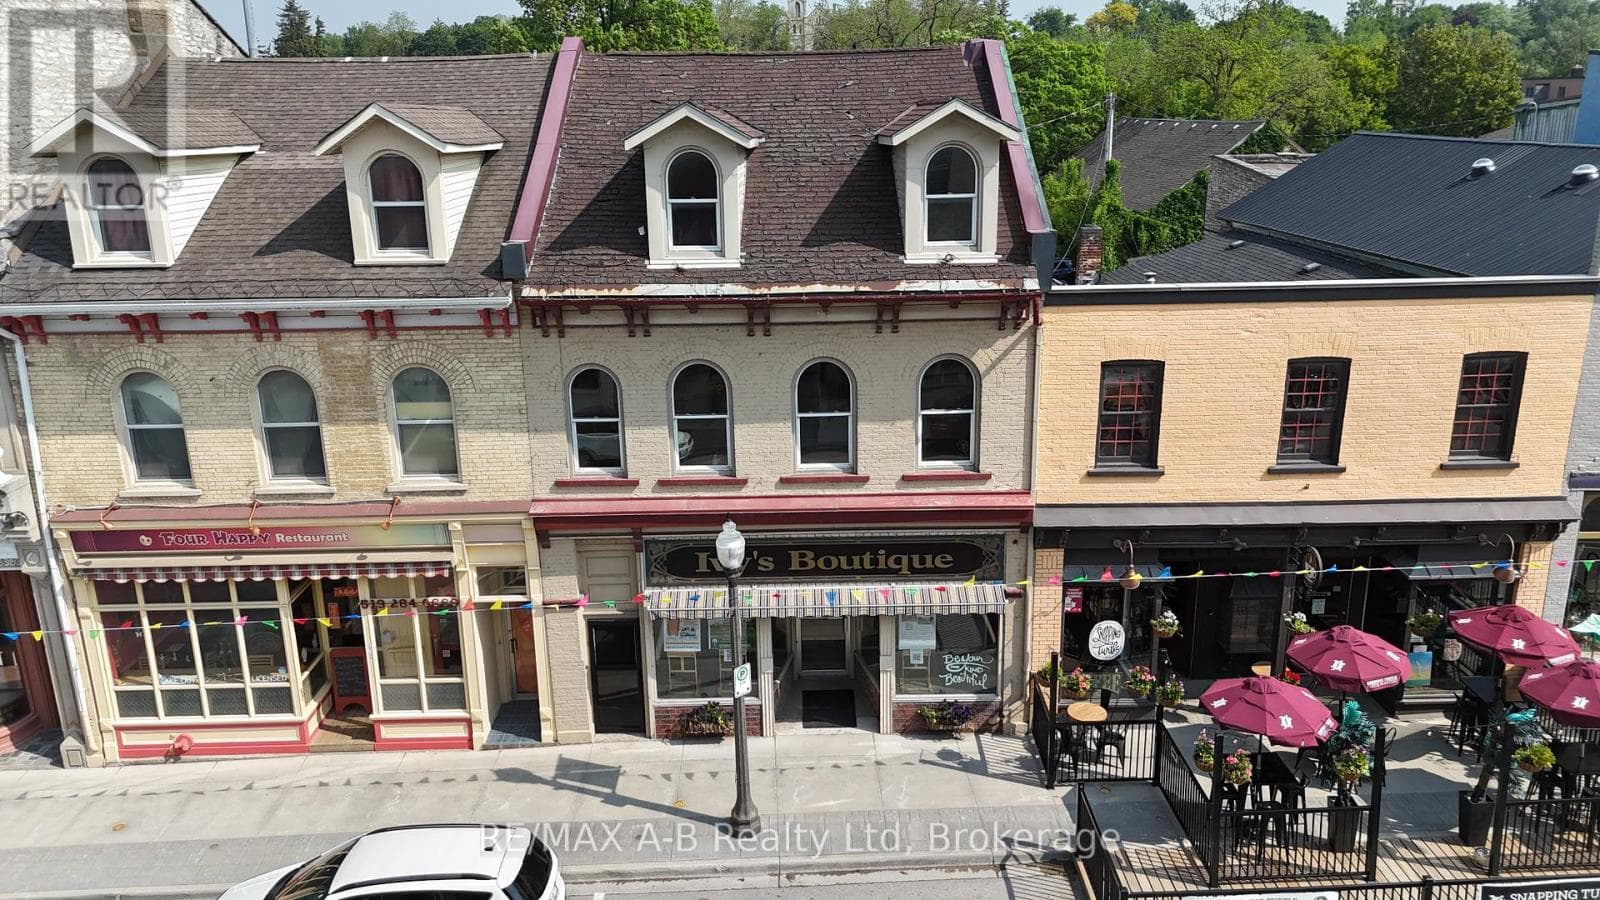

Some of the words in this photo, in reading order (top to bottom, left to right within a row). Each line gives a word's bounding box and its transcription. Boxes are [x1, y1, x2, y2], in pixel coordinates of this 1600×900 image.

[275, 532, 349, 544] Restaurant
[787, 549, 954, 575] Boutique
[391, 598, 417, 608] 284
